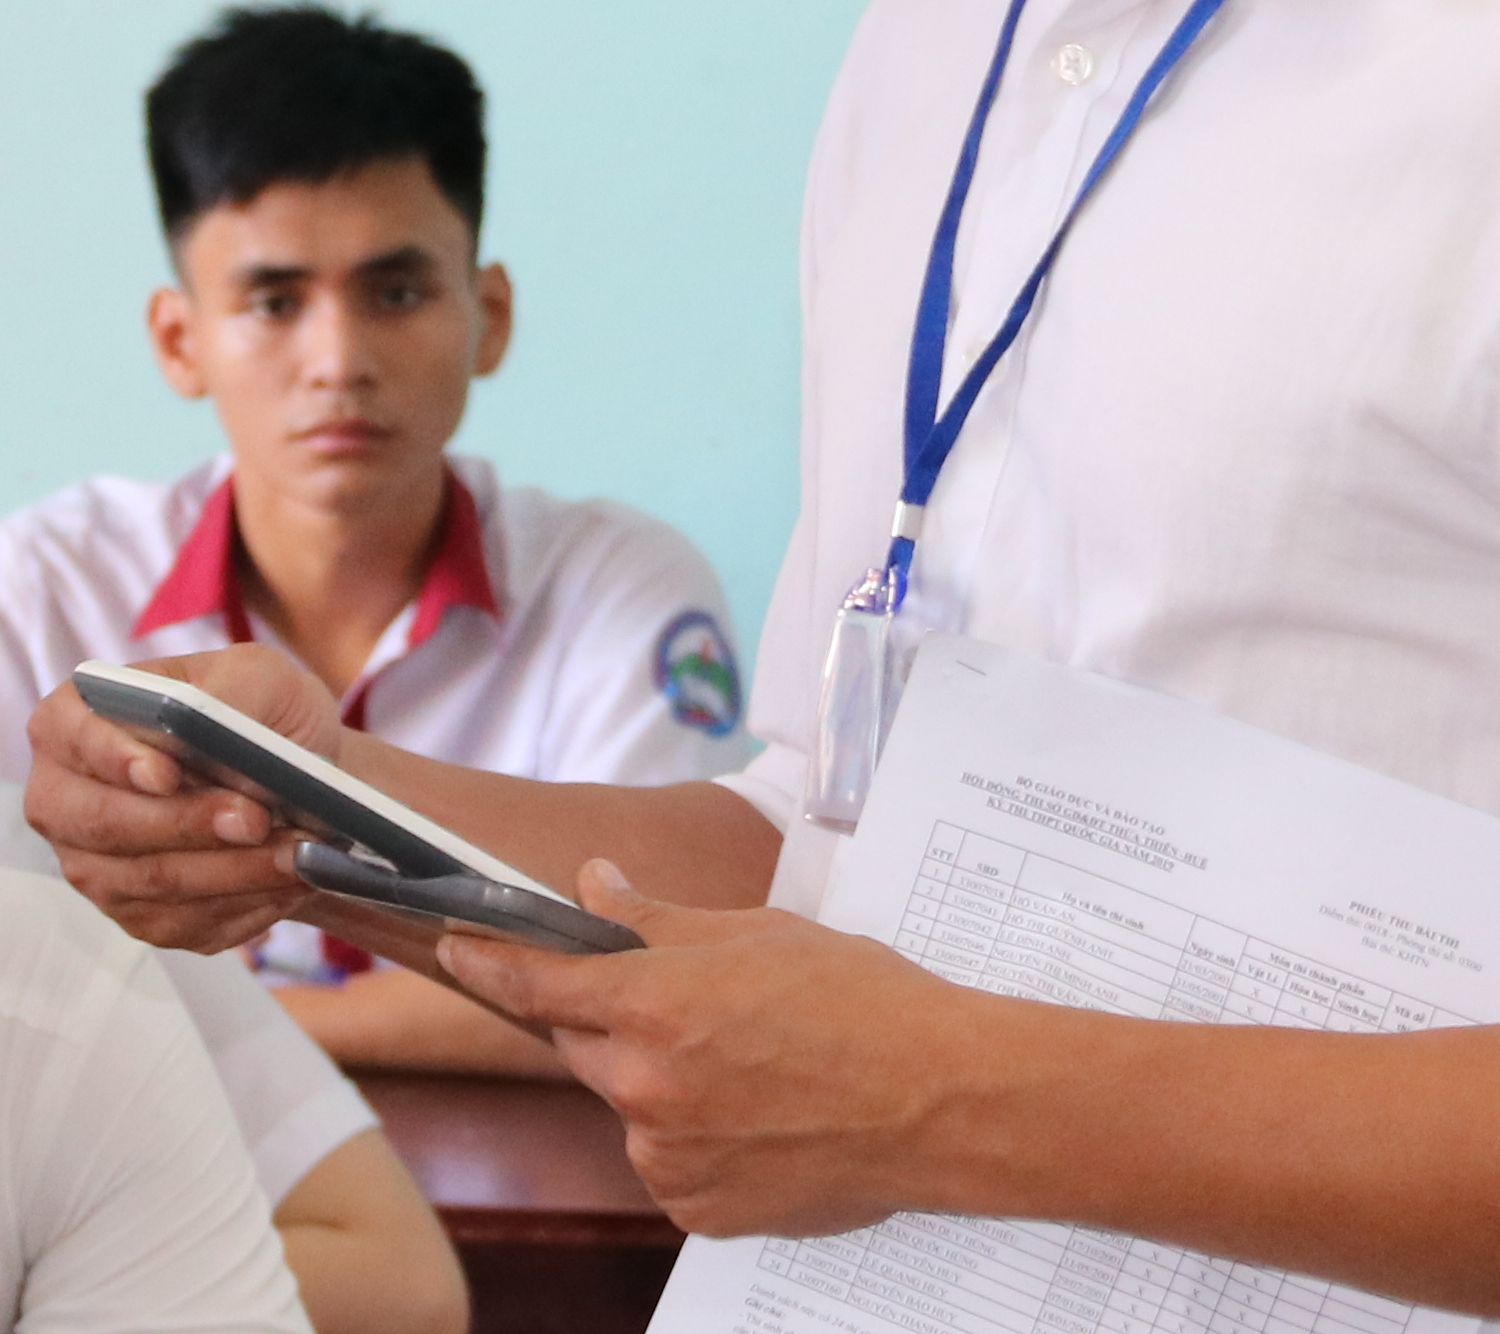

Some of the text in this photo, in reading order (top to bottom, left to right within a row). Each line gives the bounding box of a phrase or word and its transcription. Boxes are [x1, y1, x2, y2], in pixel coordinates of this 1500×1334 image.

[960, 771, 985, 788] HỘI
[1023, 793, 1044, 808] THI
[1014, 773, 1033, 790] BỘ
[1034, 781, 1066, 800] GIÁO
[1066, 793, 1092, 810] DỤC
[1093, 801, 1111, 816] VÀ
[1140, 820, 1166, 837] TẠO
[1007, 802, 1028, 818] THI
[1030, 811, 1060, 829] THPT
[1061, 820, 1097, 842] QUỐC
[1097, 835, 1121, 850] GIA
[1148, 854, 1175, 871] 2019
[930, 846, 953, 861] STT
[975, 861, 999, 877] SBD
[1124, 915, 1145, 930] sinh
[1389, 915, 1409, 930] THU
[1439, 934, 1460, 949] THI
[1046, 944, 1072, 961] ANH
[1086, 942, 1114, 960] ANH
[1214, 952, 1236, 967] sinh
[1396, 948, 1430, 968] KHTN
[1267, 952, 1292, 969] Môn
[1292, 962, 1307, 975] thi
[1310, 989, 1330, 1005] học
[1336, 998, 1380, 1024] Sinh học
[921, 1280, 947, 1298] HUY
[743, 1296, 763, 1311] Ghi
[830, 1316, 845, 1329] 24
[930, 1305, 957, 1323] HUY
